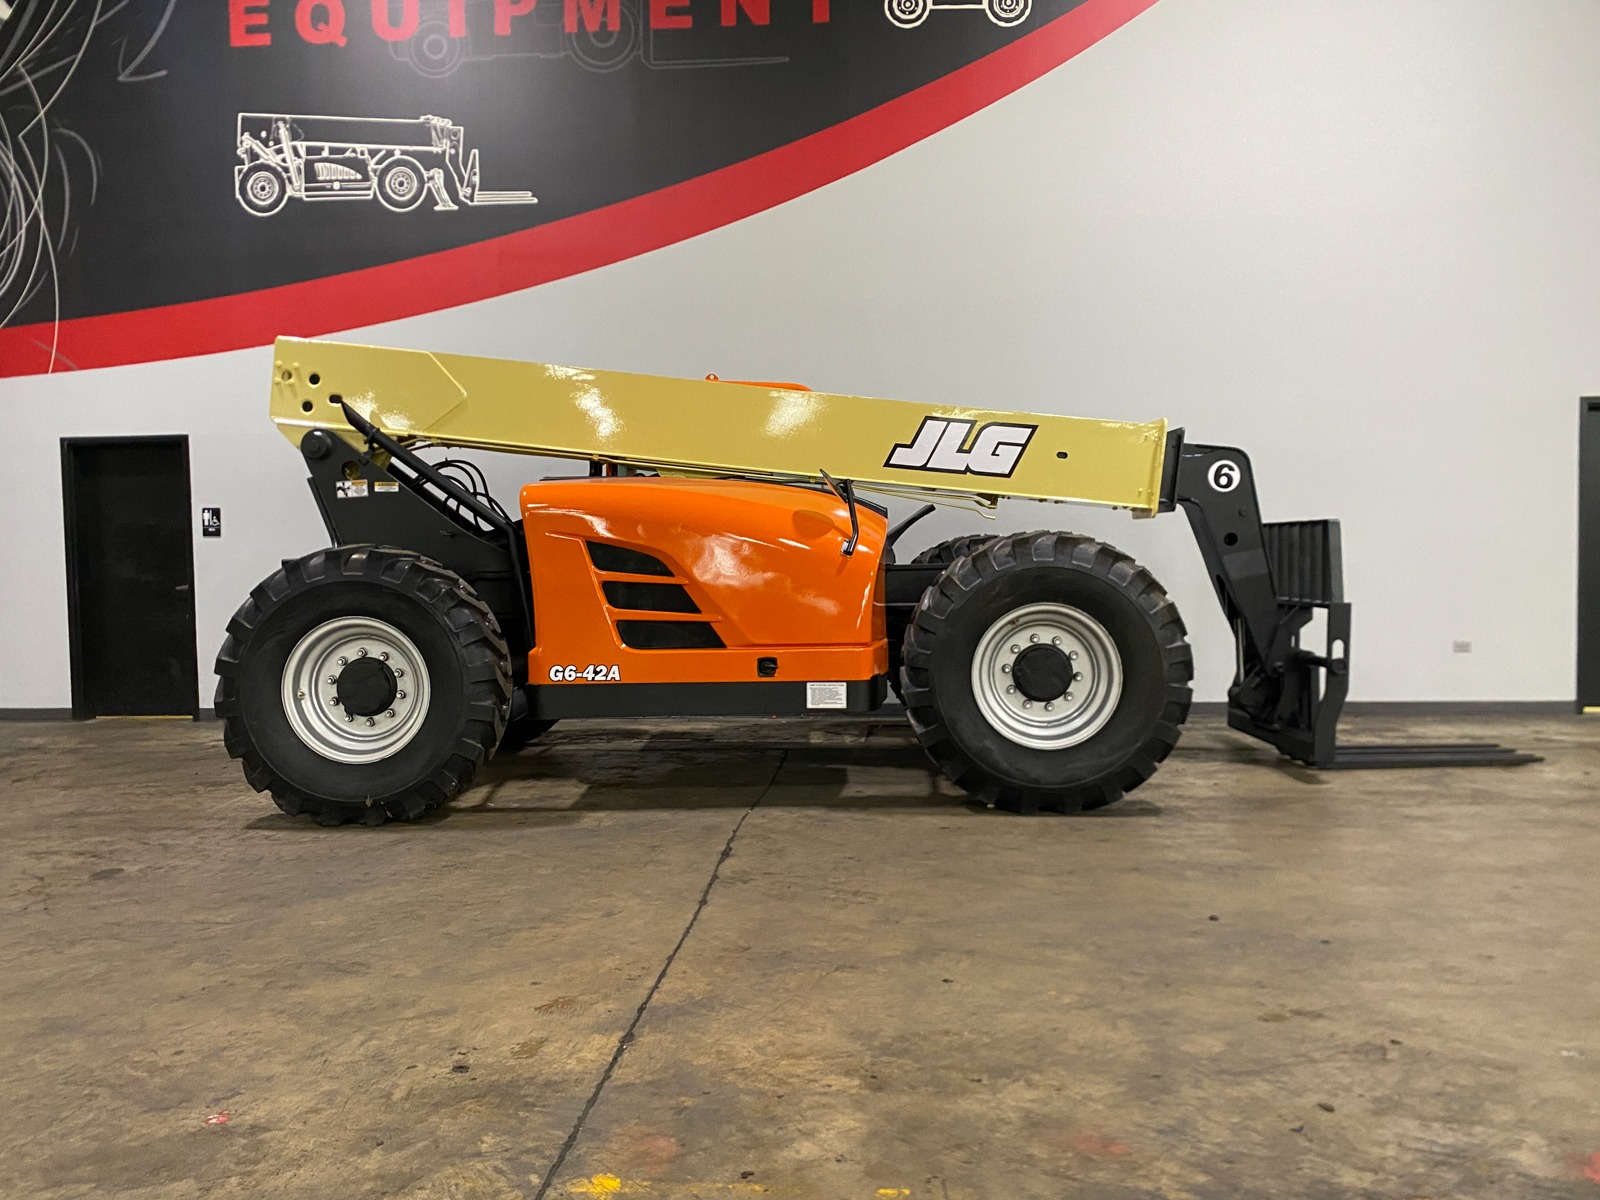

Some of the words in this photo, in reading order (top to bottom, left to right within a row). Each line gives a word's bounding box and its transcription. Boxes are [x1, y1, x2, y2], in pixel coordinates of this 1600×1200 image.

[884, 416, 1038, 478] JLG
[1213, 463, 1235, 489] 6
[549, 664, 621, 681] G6-42A
